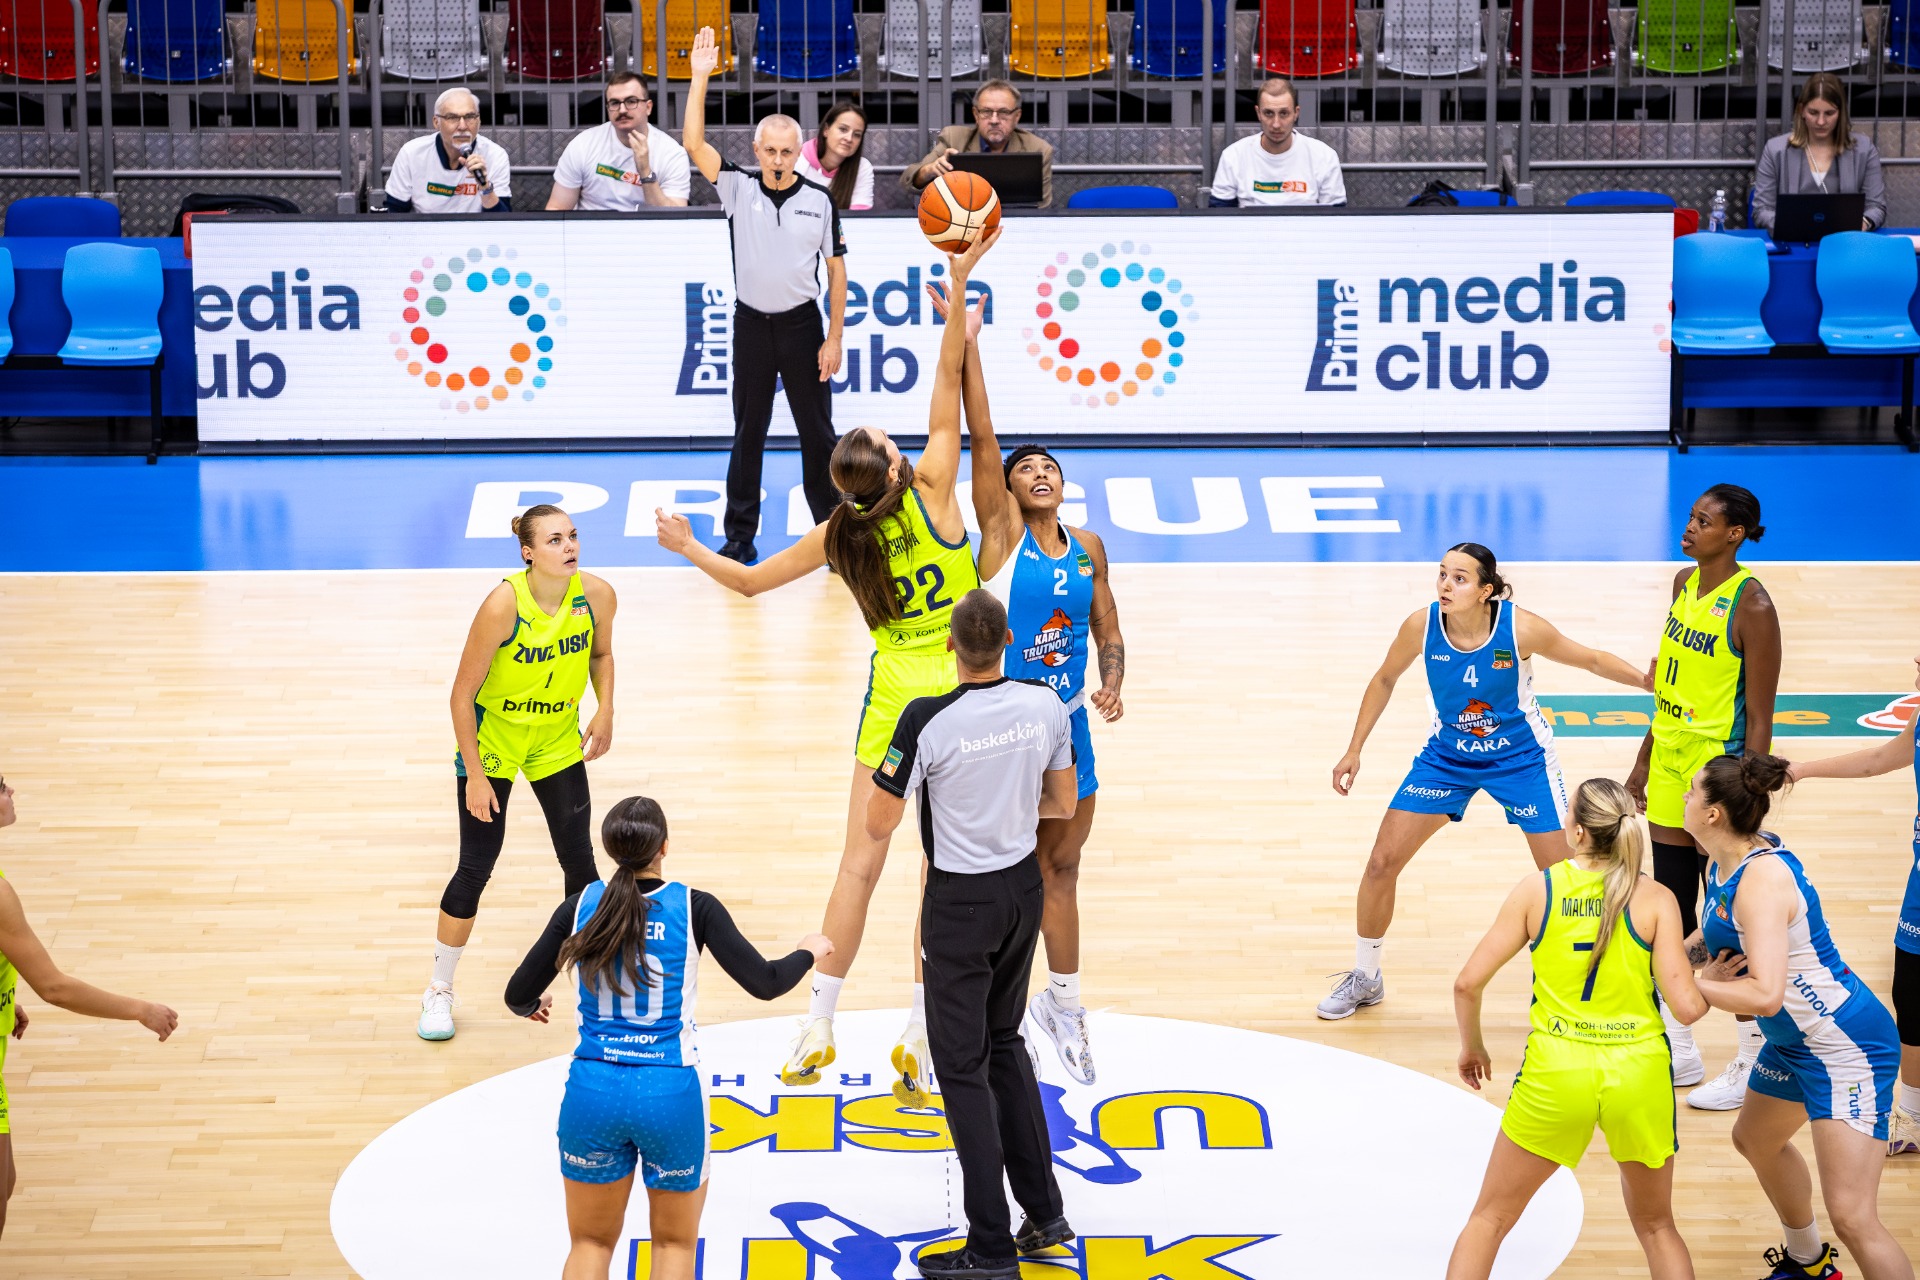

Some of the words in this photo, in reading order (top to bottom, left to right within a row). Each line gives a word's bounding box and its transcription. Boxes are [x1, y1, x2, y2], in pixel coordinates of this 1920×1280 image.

[193, 268, 361, 332] edia
[823, 263, 994, 327] edia
[1378, 260, 1626, 323] media
[691, 281, 728, 390] Prima
[1320, 278, 1358, 387] Prima
[195, 339, 287, 399] ub
[1375, 331, 1550, 392] club
[465, 476, 1401, 539] PRUE
[897, 563, 954, 619] 22
[1053, 567, 1069, 596] 2
[915, 622, 951, 638] KOH-I-N
[1034, 630, 1061, 646] KARA
[1682, 627, 1720, 658] USK
[513, 642, 556, 664] ZVVZ
[558, 629, 591, 656] USK
[1022, 636, 1069, 660] TRUTNOV
[1430, 654, 1451, 662] JAKO
[544, 670, 554, 689] 1
[1463, 664, 1479, 688] 4
[1665, 656, 1679, 686] 11
[1540, 706, 1832, 726] hae
[1655, 690, 1683, 719] ima
[1456, 737, 1511, 753] KARA
[1402, 783, 1451, 799] Autostyl
[1562, 895, 1604, 917] MALÍKO
[1573, 942, 1603, 1002] 7
[0, 984, 15, 1012] pri
[598, 953, 664, 1026] 10
[1792, 973, 1833, 1019] utnov
[1574, 1021, 1636, 1031] KOH-I-NOOR
[1753, 1061, 1792, 1082] utostyl
